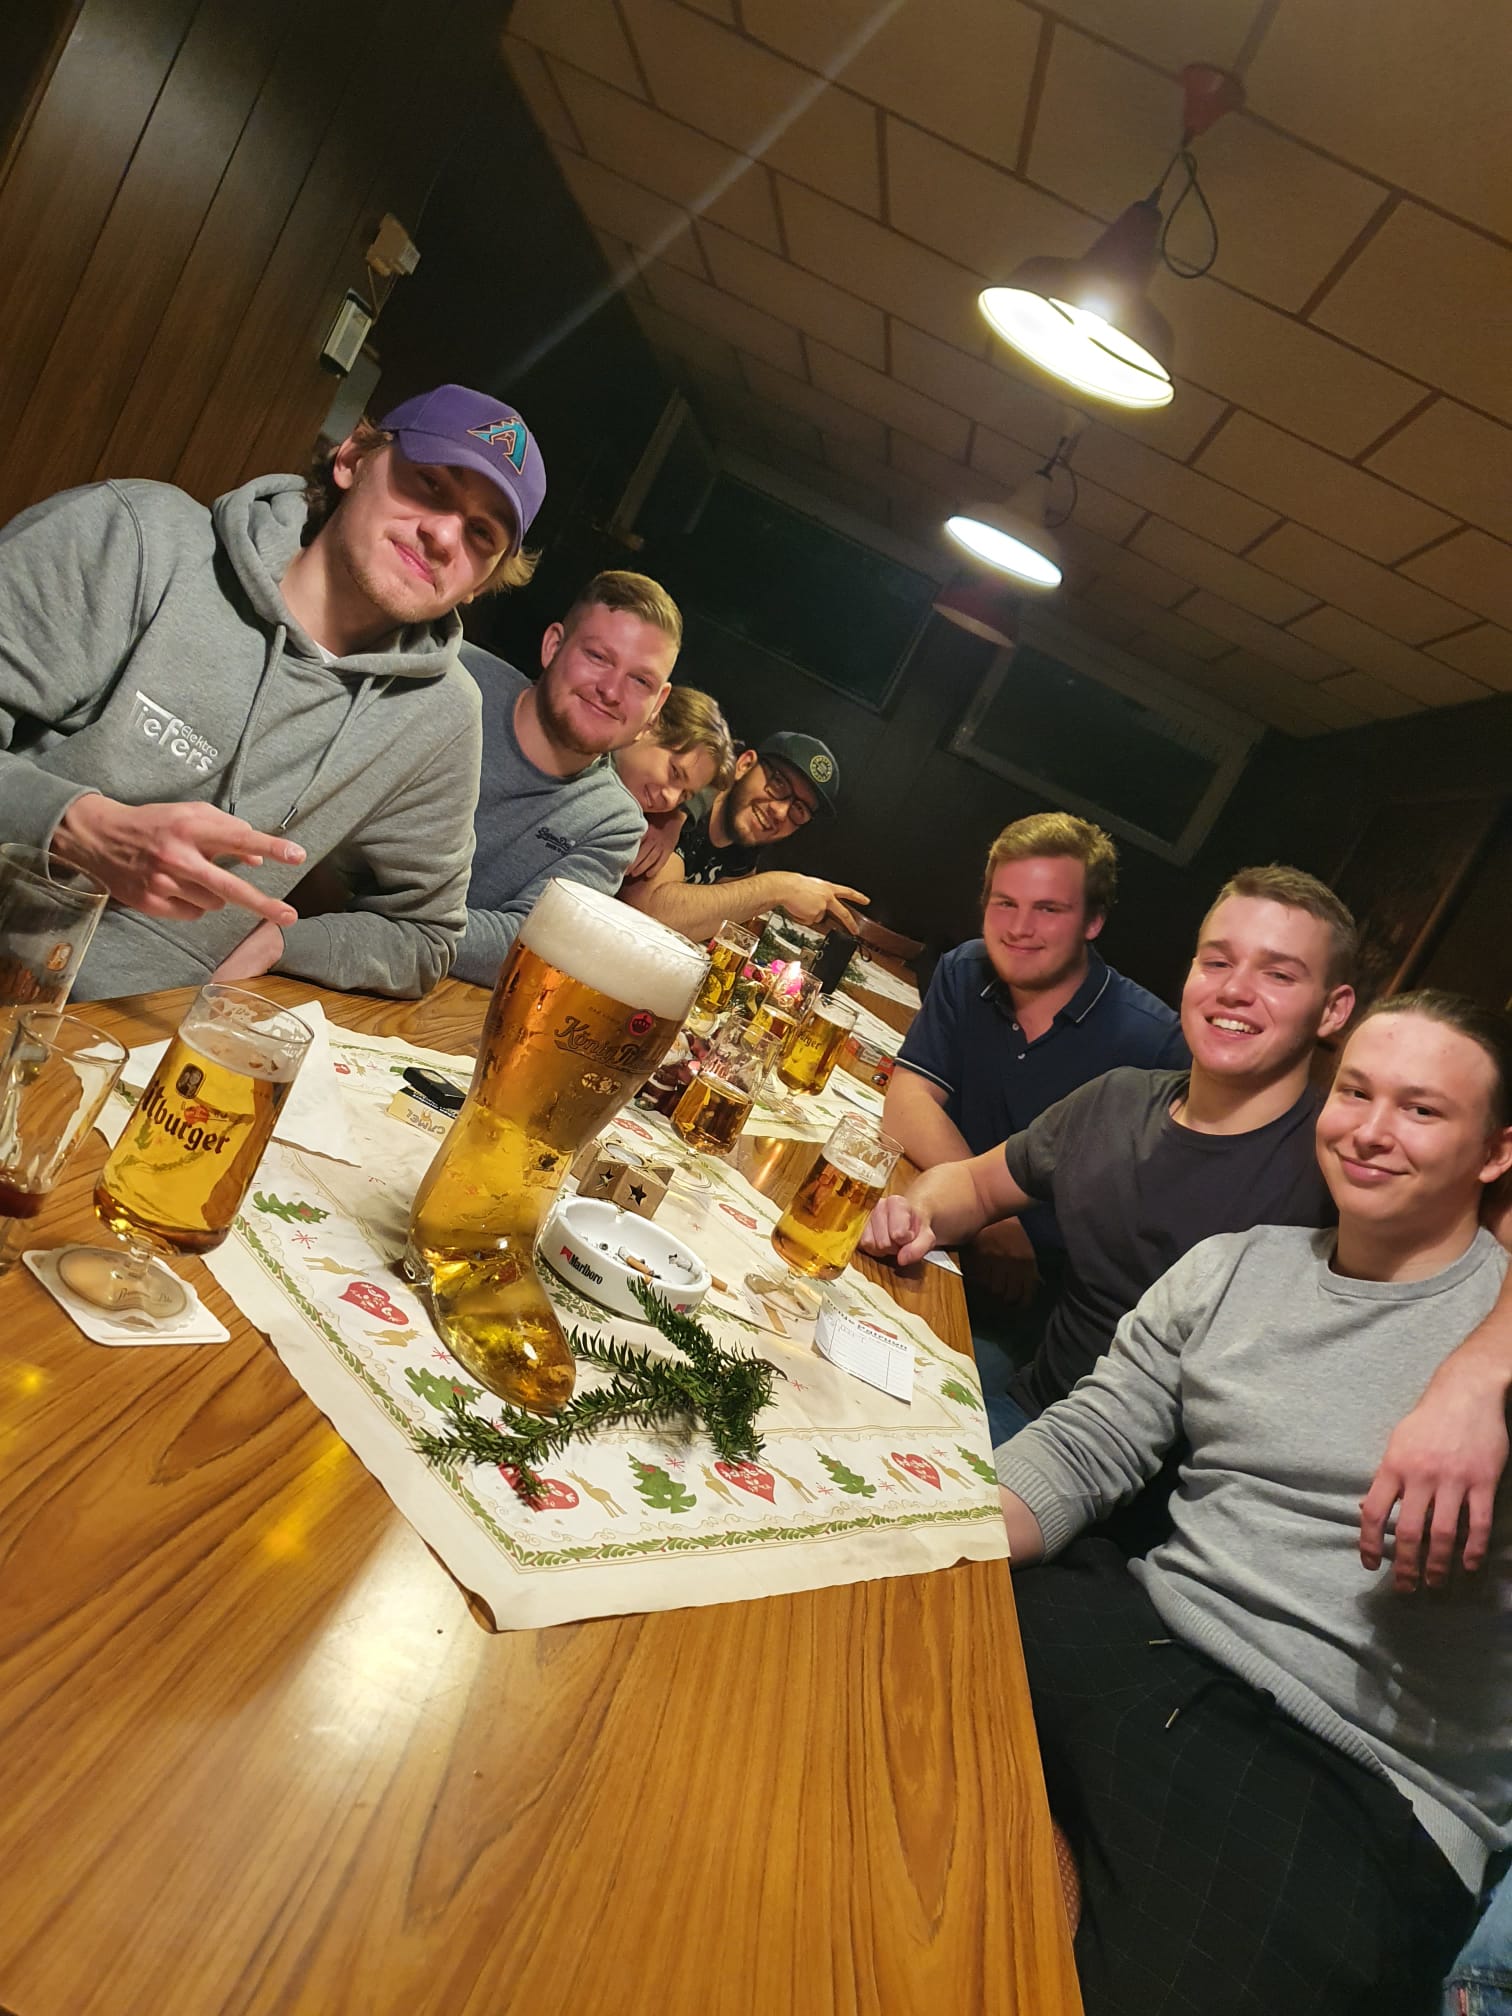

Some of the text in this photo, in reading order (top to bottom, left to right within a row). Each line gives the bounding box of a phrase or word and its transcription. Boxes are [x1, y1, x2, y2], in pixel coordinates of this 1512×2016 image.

[181, 725, 218, 757] Elektro
[554, 1015, 619, 1065] König
[405, 1108, 446, 1135] CAMEL
[568, 1254, 604, 1285] Marlboro
